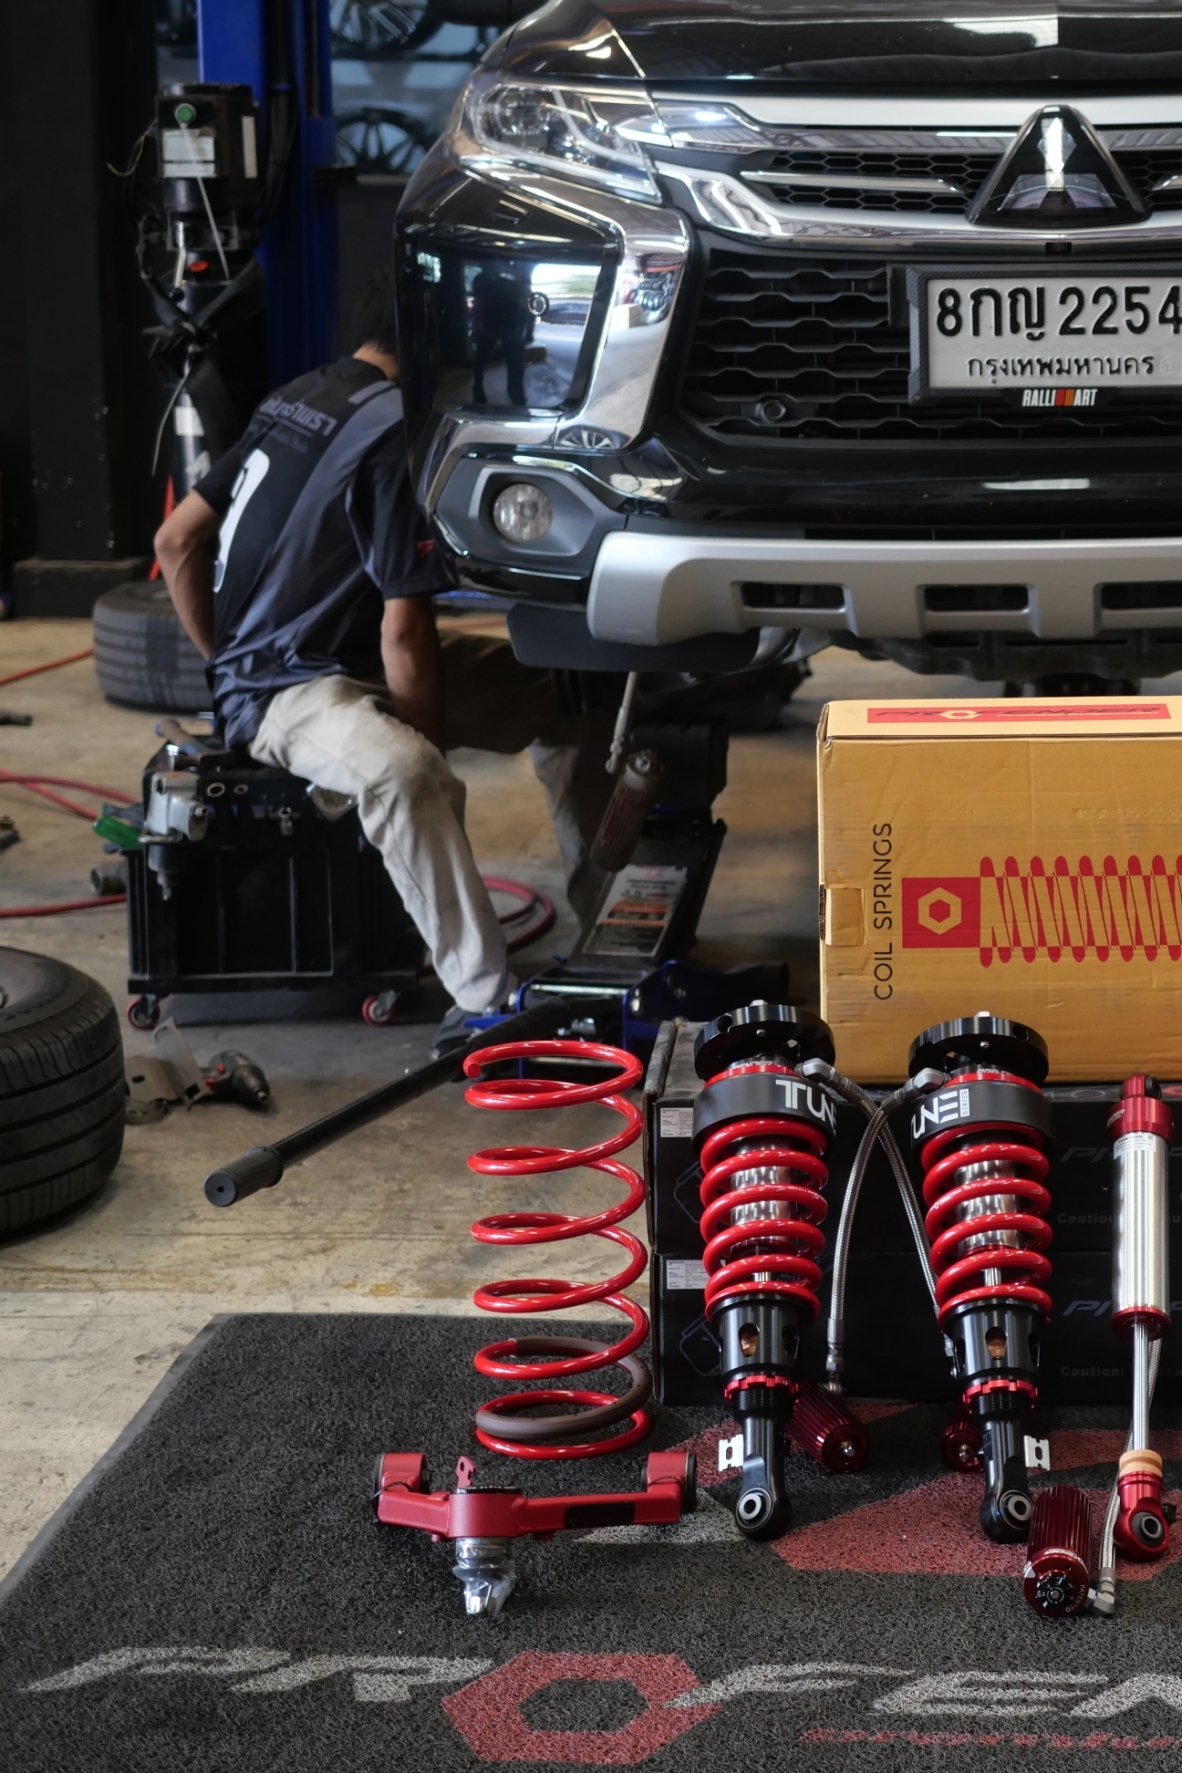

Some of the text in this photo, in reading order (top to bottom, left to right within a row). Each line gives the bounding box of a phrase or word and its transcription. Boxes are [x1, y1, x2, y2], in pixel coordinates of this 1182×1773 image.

[936, 285, 1046, 341] 8กญ
[967, 355, 1155, 385] กรุงเทพมหานคร
[872, 822, 893, 1001] COIL SPRINGS
[911, 1090, 959, 1139] UNE
[1060, 1365, 1125, 1377] Caution:
